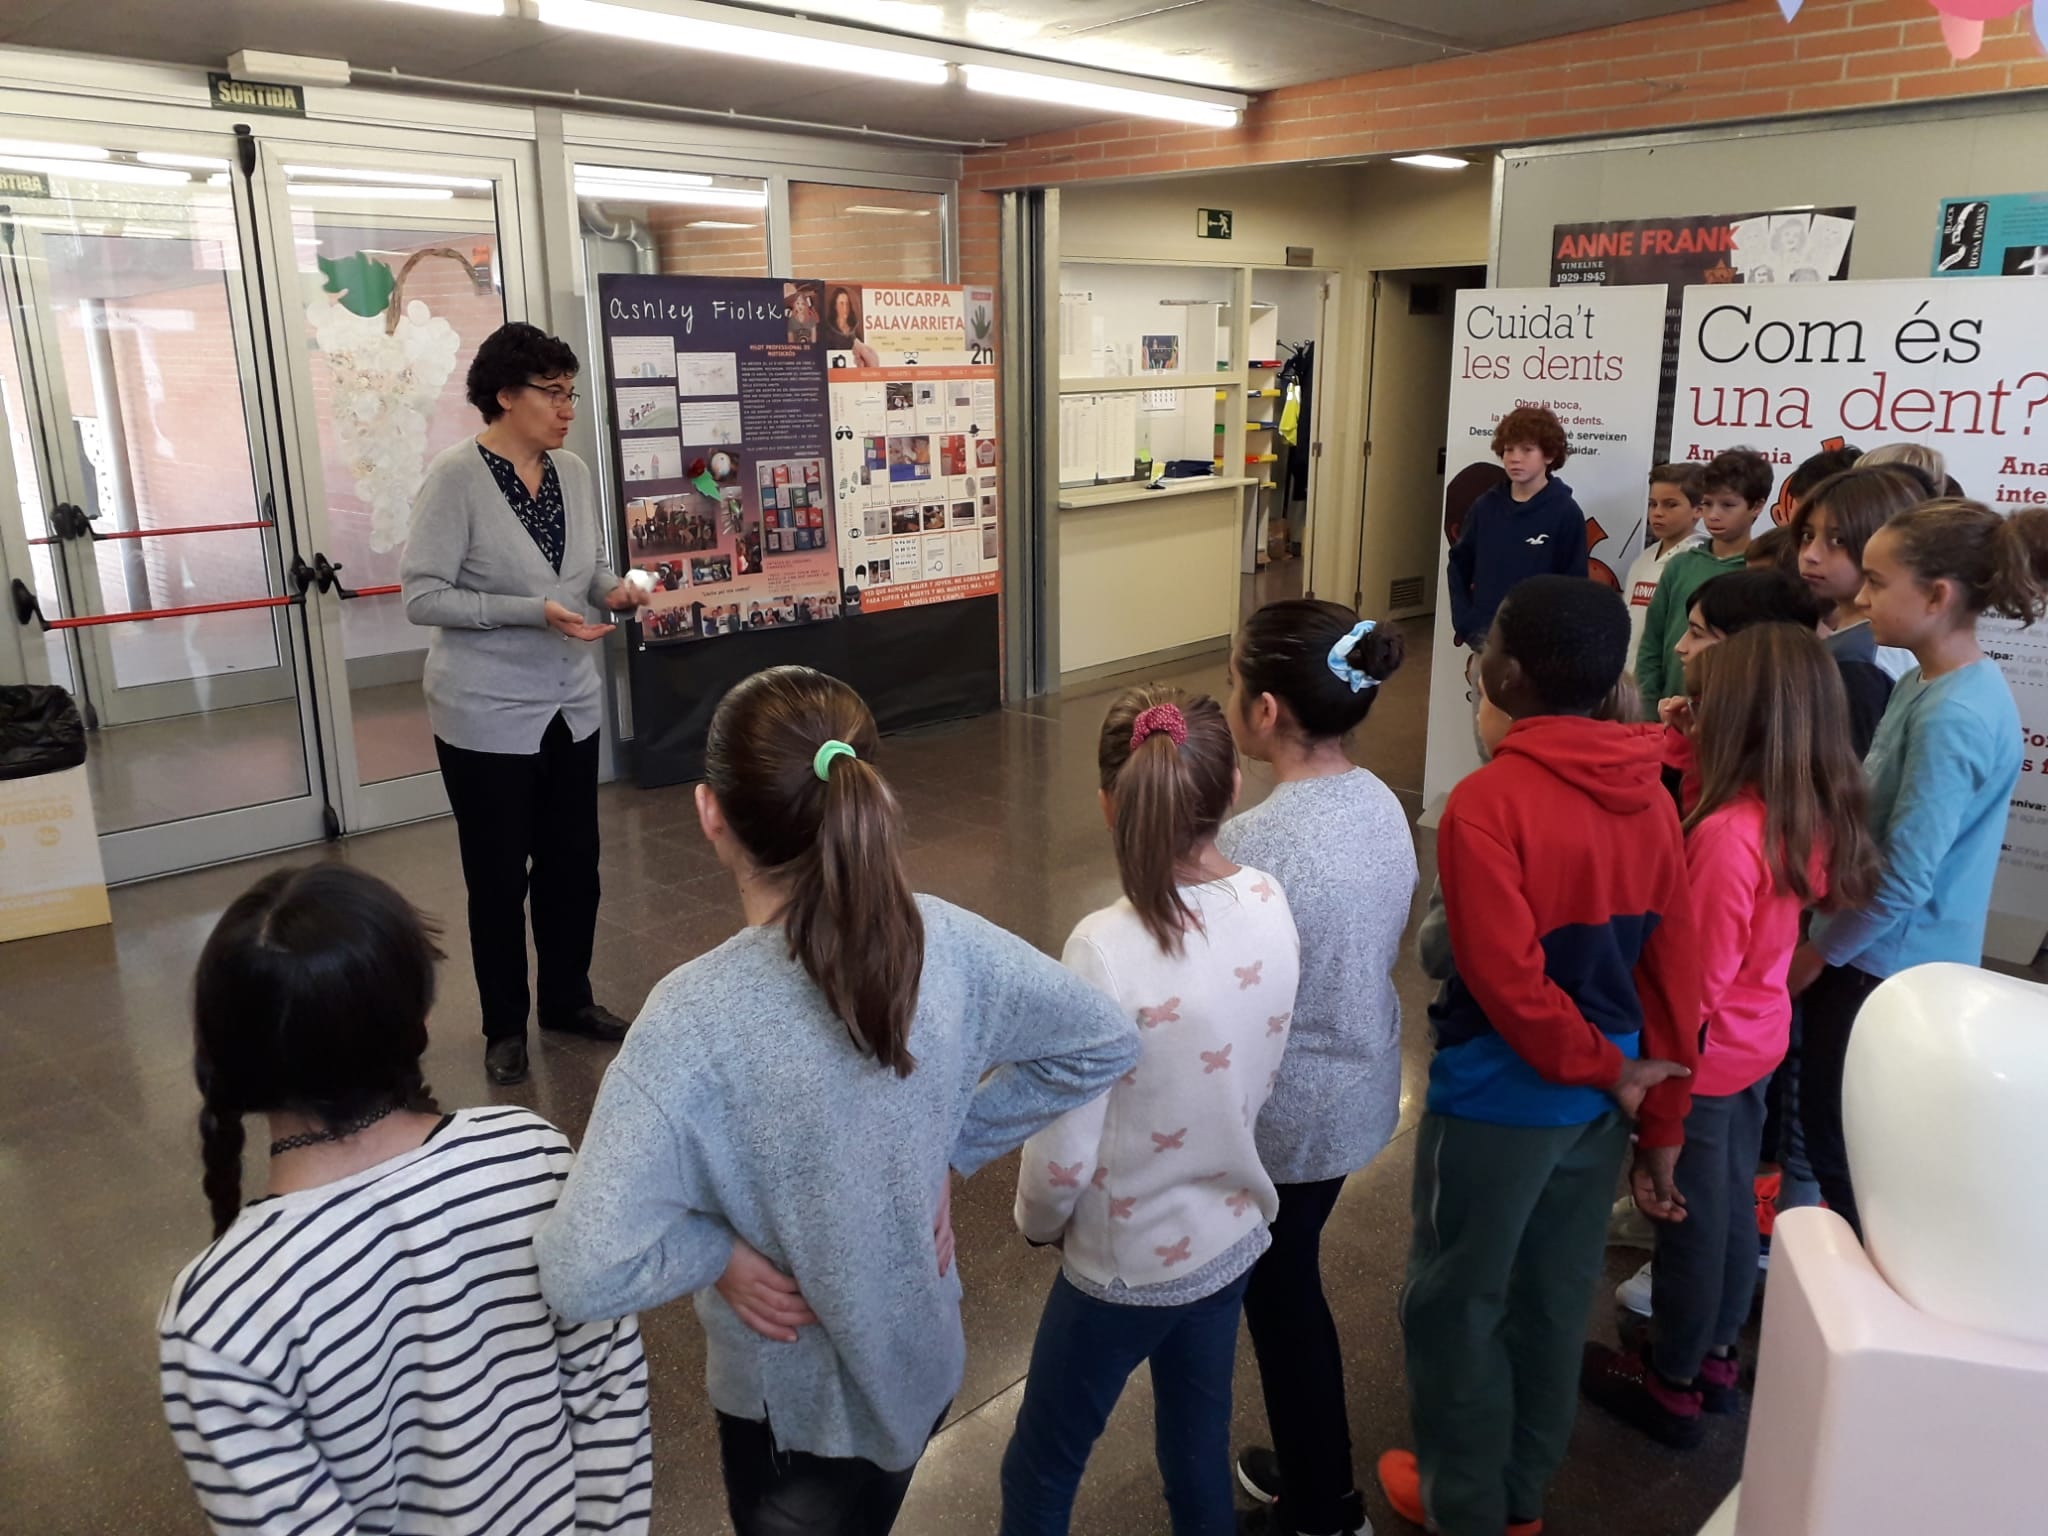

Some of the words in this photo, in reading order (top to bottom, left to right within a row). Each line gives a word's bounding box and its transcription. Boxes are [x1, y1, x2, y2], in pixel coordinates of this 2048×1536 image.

[217, 80, 298, 109] SORTIDA
[1973, 206, 1986, 238] PARKS
[1556, 231, 1635, 259] ANNE
[1640, 225, 1742, 256] FRANK
[1968, 240, 1981, 267] ROSA
[1561, 261, 1605, 270] TIMELINE
[1556, 272, 1606, 283] 1929-1945
[875, 291, 951, 307] POLICARPA
[865, 315, 965, 330] SALAVARRIETA
[1467, 304, 1595, 340] Cuida't
[1698, 305, 1866, 364] Com
[1895, 300, 1983, 364] és
[970, 343, 994, 365] 2n
[1462, 346, 1511, 380] les
[1523, 346, 1623, 381] dents
[1542, 400, 1550, 409] la
[1554, 400, 1582, 411] boca,
[1689, 386, 1813, 430] una
[1840, 371, 2048, 436] dent?
[1491, 413, 1500, 422] la
[1572, 416, 1605, 426] dents.
[1576, 431, 1628, 442] serveixen
[1996, 484, 2048, 504] inte
[911, 582, 927, 590] MUJER
[2010, 800, 2047, 812] eniva:
